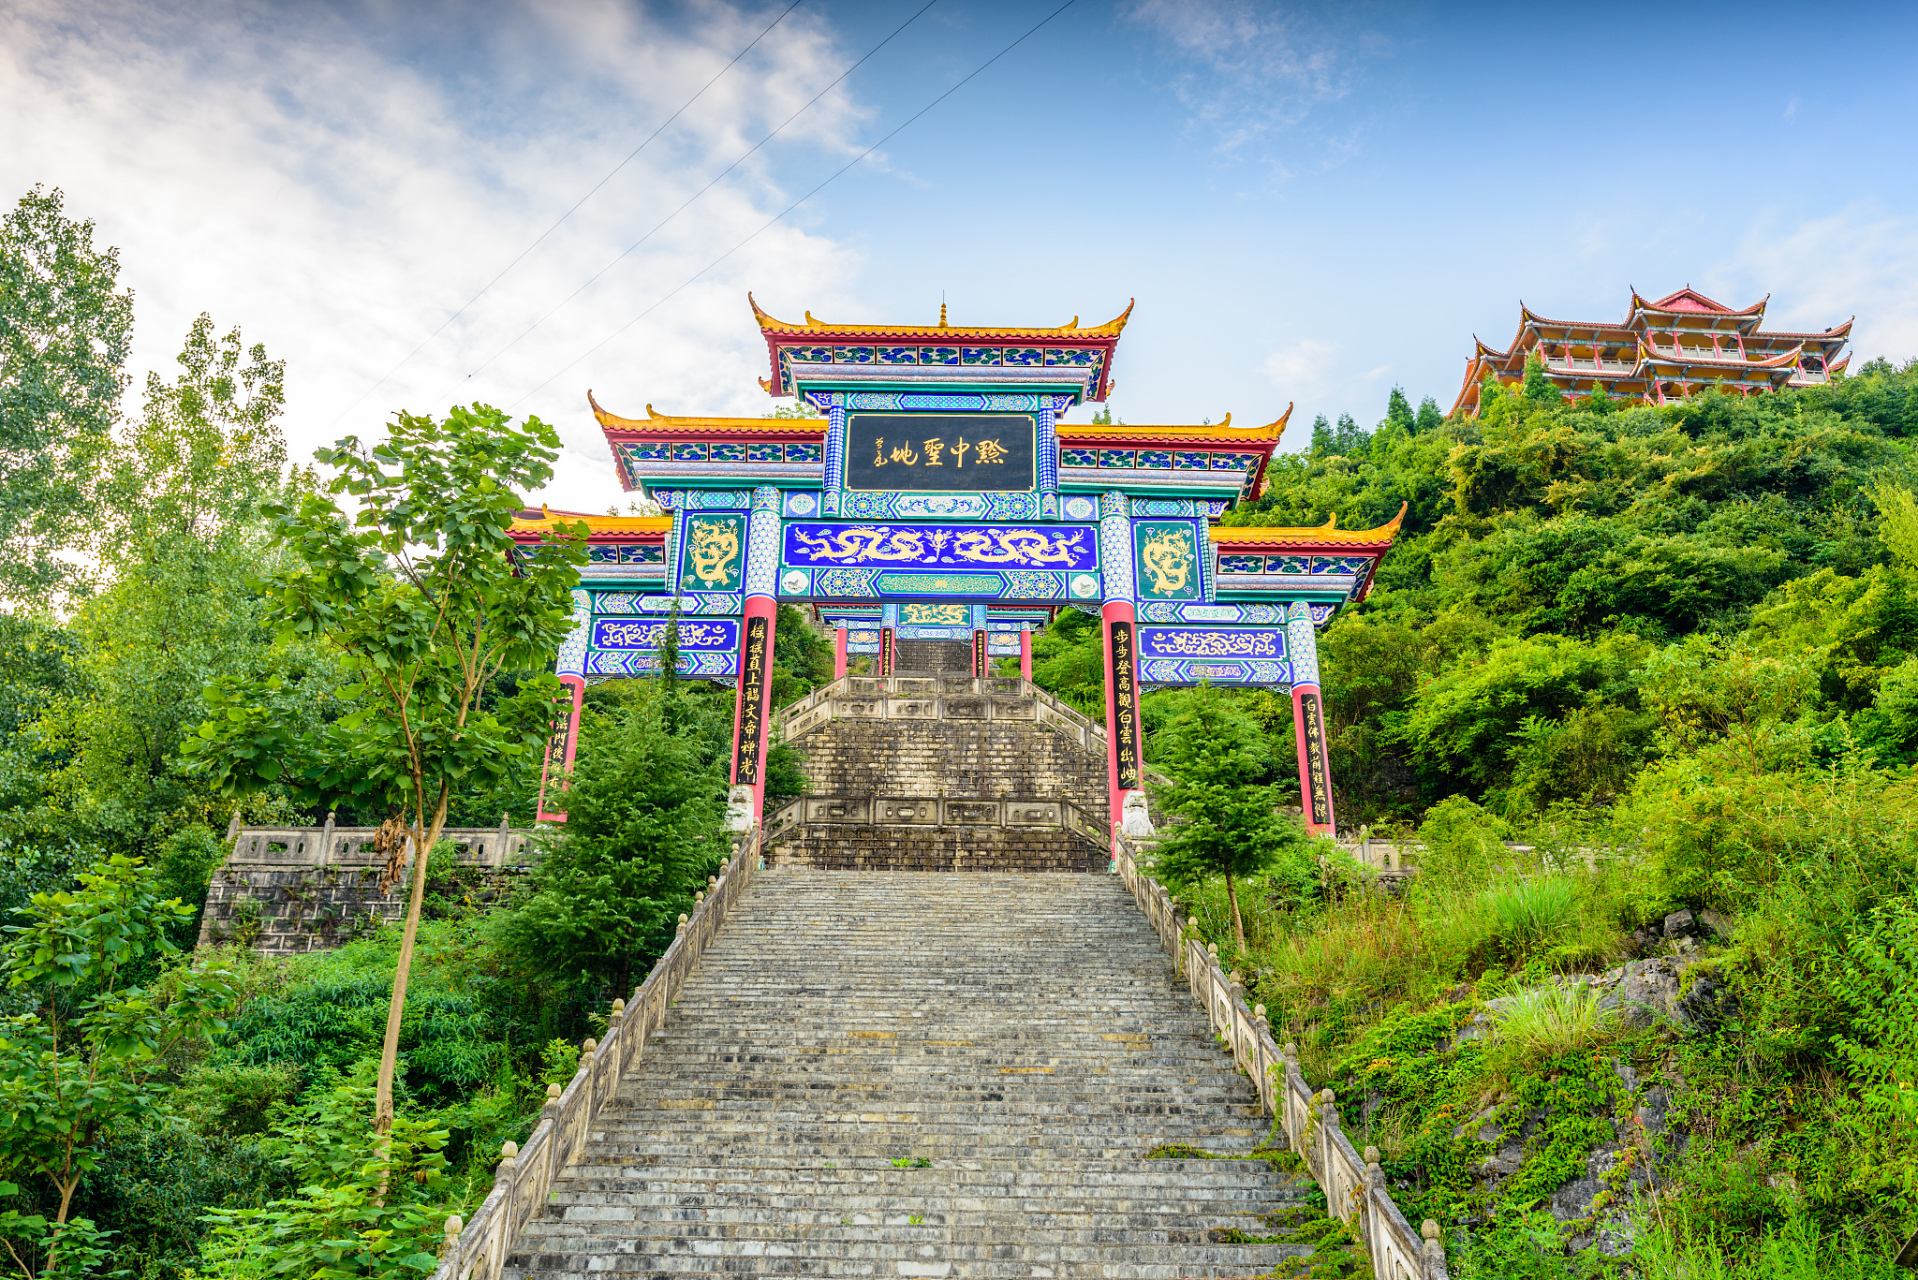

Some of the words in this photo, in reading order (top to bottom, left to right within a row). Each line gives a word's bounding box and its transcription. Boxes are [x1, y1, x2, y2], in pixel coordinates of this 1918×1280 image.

[1114, 628, 1136, 780] 步步登高觀白雲出岫
